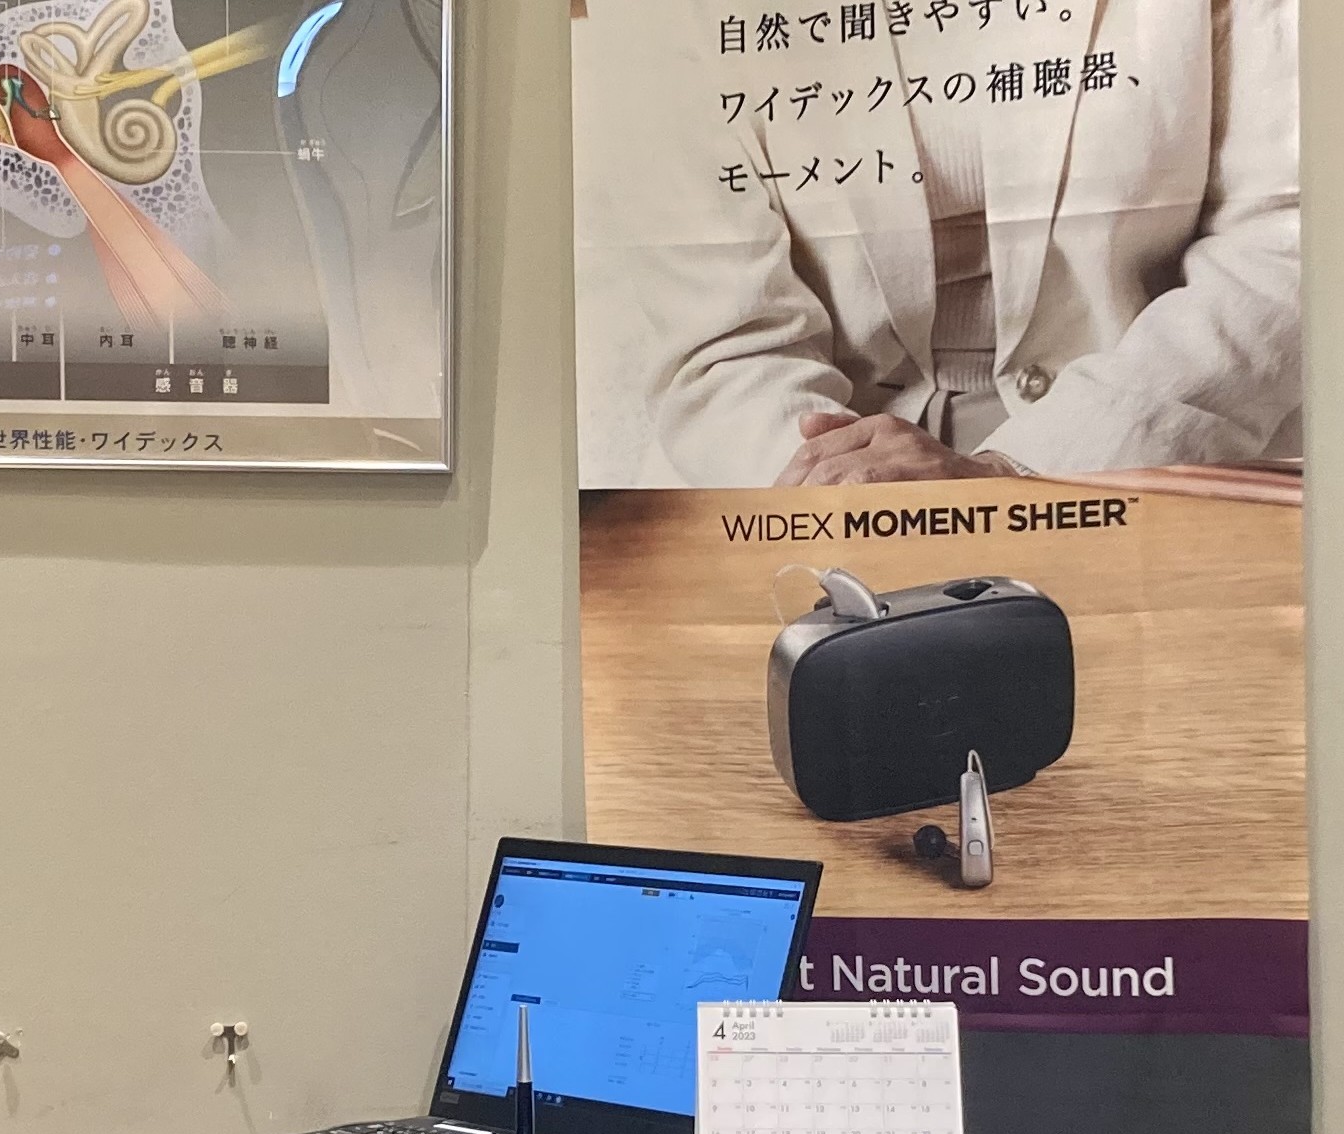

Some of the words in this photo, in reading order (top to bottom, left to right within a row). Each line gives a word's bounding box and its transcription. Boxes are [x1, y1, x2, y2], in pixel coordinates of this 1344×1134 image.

[719, 0, 1073, 55] 自然で聞きやすい。
[720, 51, 1143, 126] ワイデックスの補聴器、
[718, 148, 926, 194] モーメント。
[721, 511, 836, 542] WIDEX
[843, 504, 998, 539] MOMENT
[833, 955, 999, 997] Natural
[1018, 957, 1176, 998] Sound
[712, 1020, 726, 1040] 4
[732, 1021, 755, 1031] April
[732, 1031, 756, 1041] 2023
